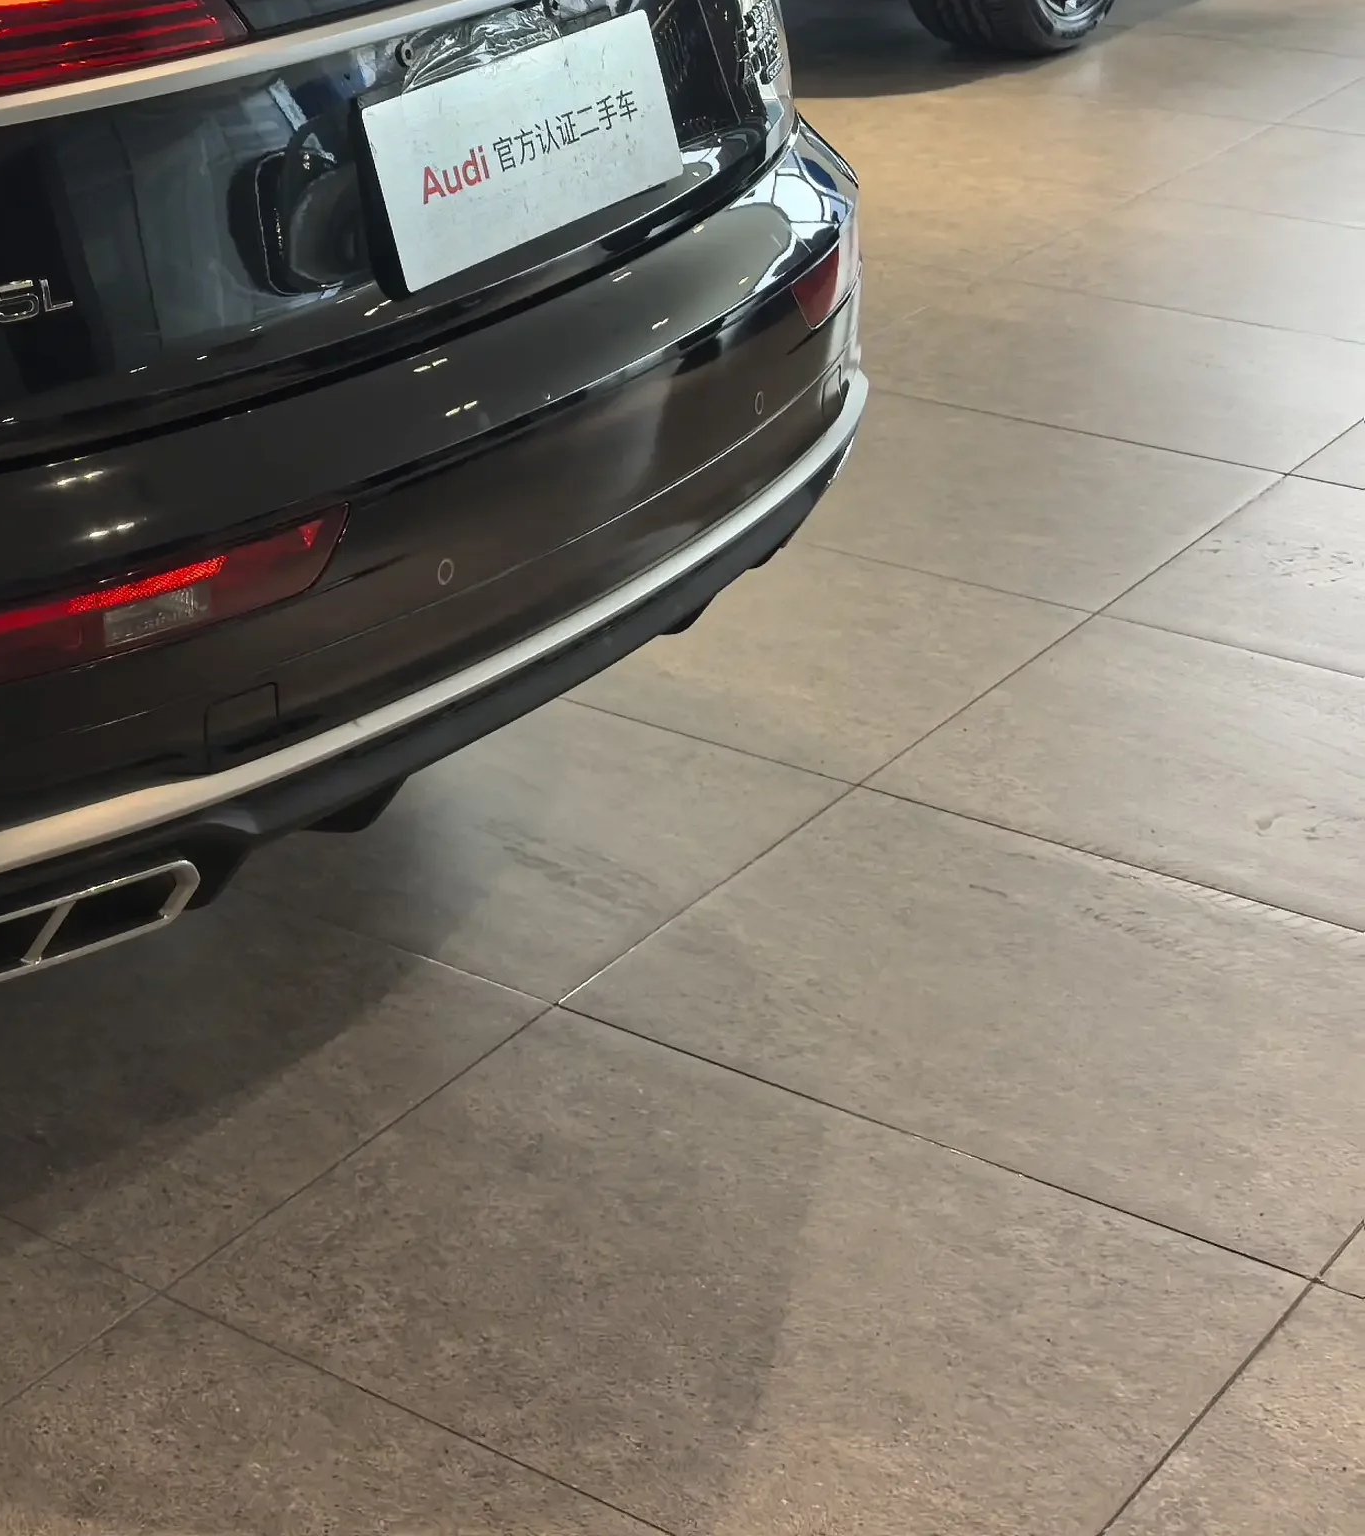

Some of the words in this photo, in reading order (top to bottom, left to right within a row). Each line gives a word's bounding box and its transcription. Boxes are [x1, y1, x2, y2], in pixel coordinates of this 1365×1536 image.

[422, 145, 490, 205] Audi
[492, 89, 639, 174] 官方认证二手车
